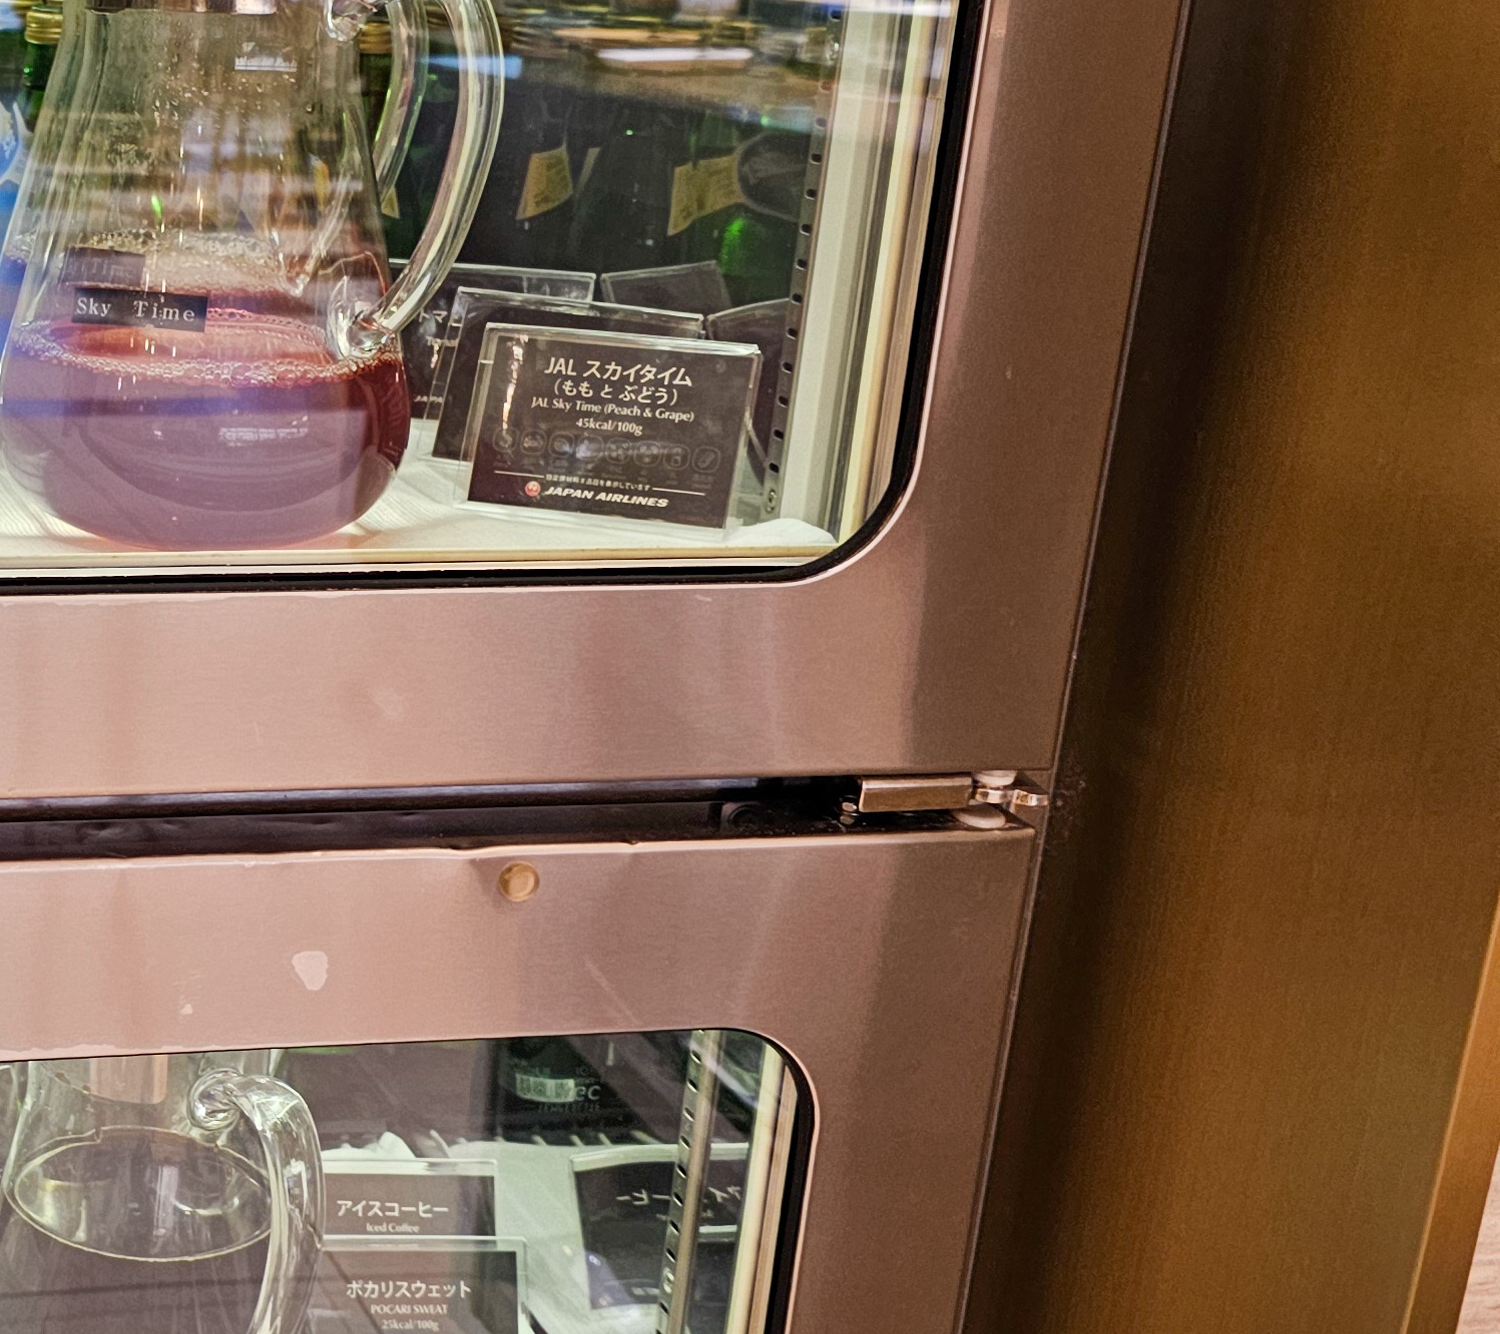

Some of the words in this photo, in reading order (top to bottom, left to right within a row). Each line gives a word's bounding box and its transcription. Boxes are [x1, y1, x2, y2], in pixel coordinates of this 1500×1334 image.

[76, 297, 111, 318] Sky
[133, 300, 195, 322] Time
[544, 357, 577, 376] JAL
[583, 359, 693, 386] スカイタイム
[600, 384, 613, 398] と
[530, 396, 549, 409] JAL
[552, 398, 572, 412] Sky
[575, 400, 601, 414] Time
[604, 403, 641, 417] (Peach
[643, 409, 653, 418] &
[655, 408, 695, 423] Grape)
[576, 417, 643, 437] 45kcal/100g
[544, 486, 594, 500] JAPAN
[595, 493, 669, 508] AIRLINES
[336, 1199, 449, 1218] アイスコーヒー
[346, 1279, 472, 1299] ポカリスウェット
[370, 1303, 411, 1315] POCARI
[413, 1303, 449, 1315] SWEAT
